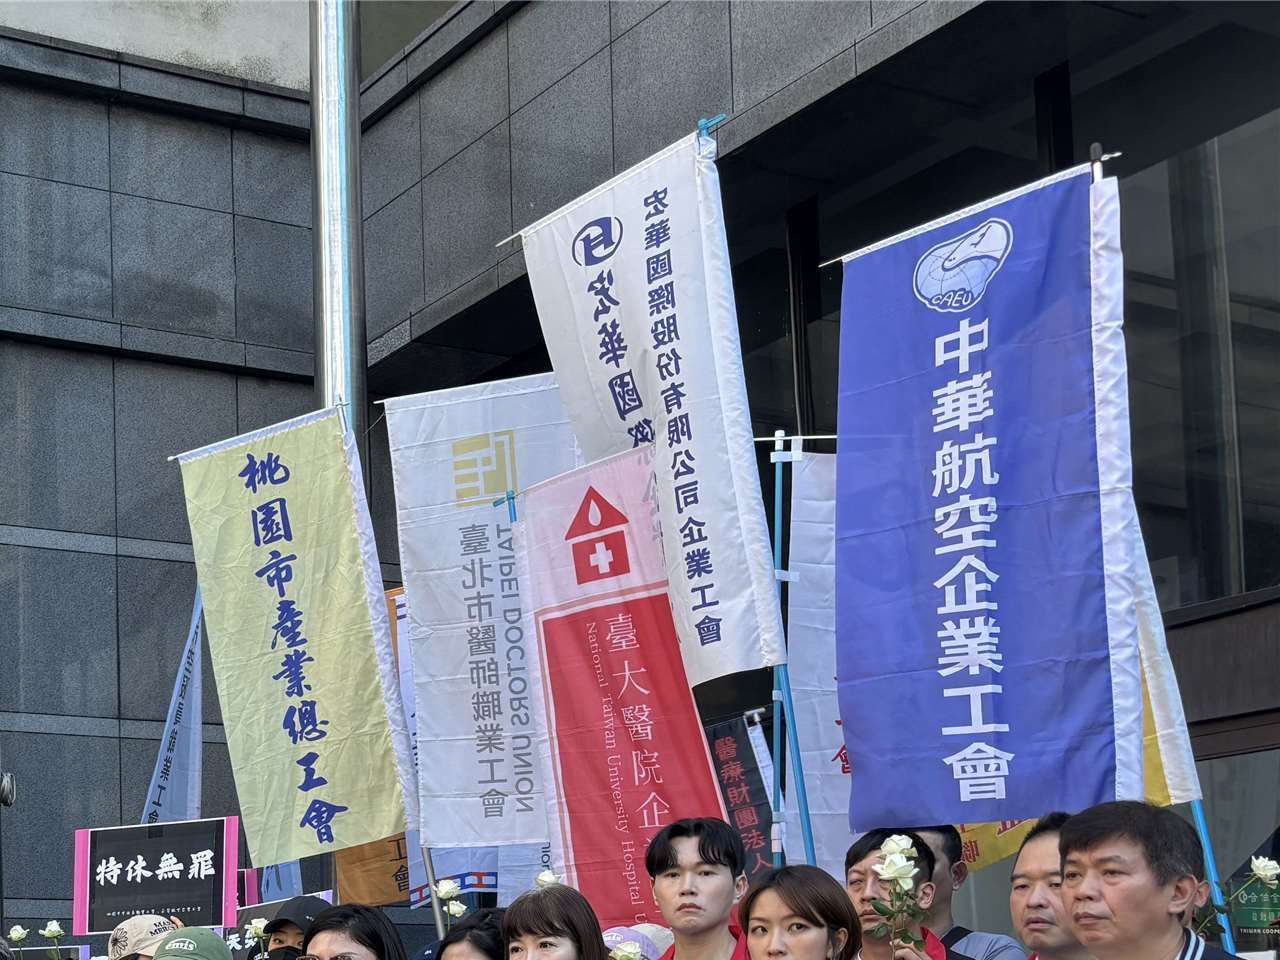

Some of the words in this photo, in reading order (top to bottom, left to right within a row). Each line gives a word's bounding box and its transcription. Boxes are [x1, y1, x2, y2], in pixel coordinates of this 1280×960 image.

[931, 288, 973, 307] CAEU
[931, 318, 1016, 803] 中華航空企業工會
[238, 453, 348, 844] 桃園市產業總工會
[585, 622, 609, 688] National
[601, 694, 618, 750] Taiwan
[605, 612, 671, 838] 臺大醫院企
[605, 751, 630, 834] University
[96, 848, 216, 887] 特休無罪
[621, 840, 645, 905] Hospital
